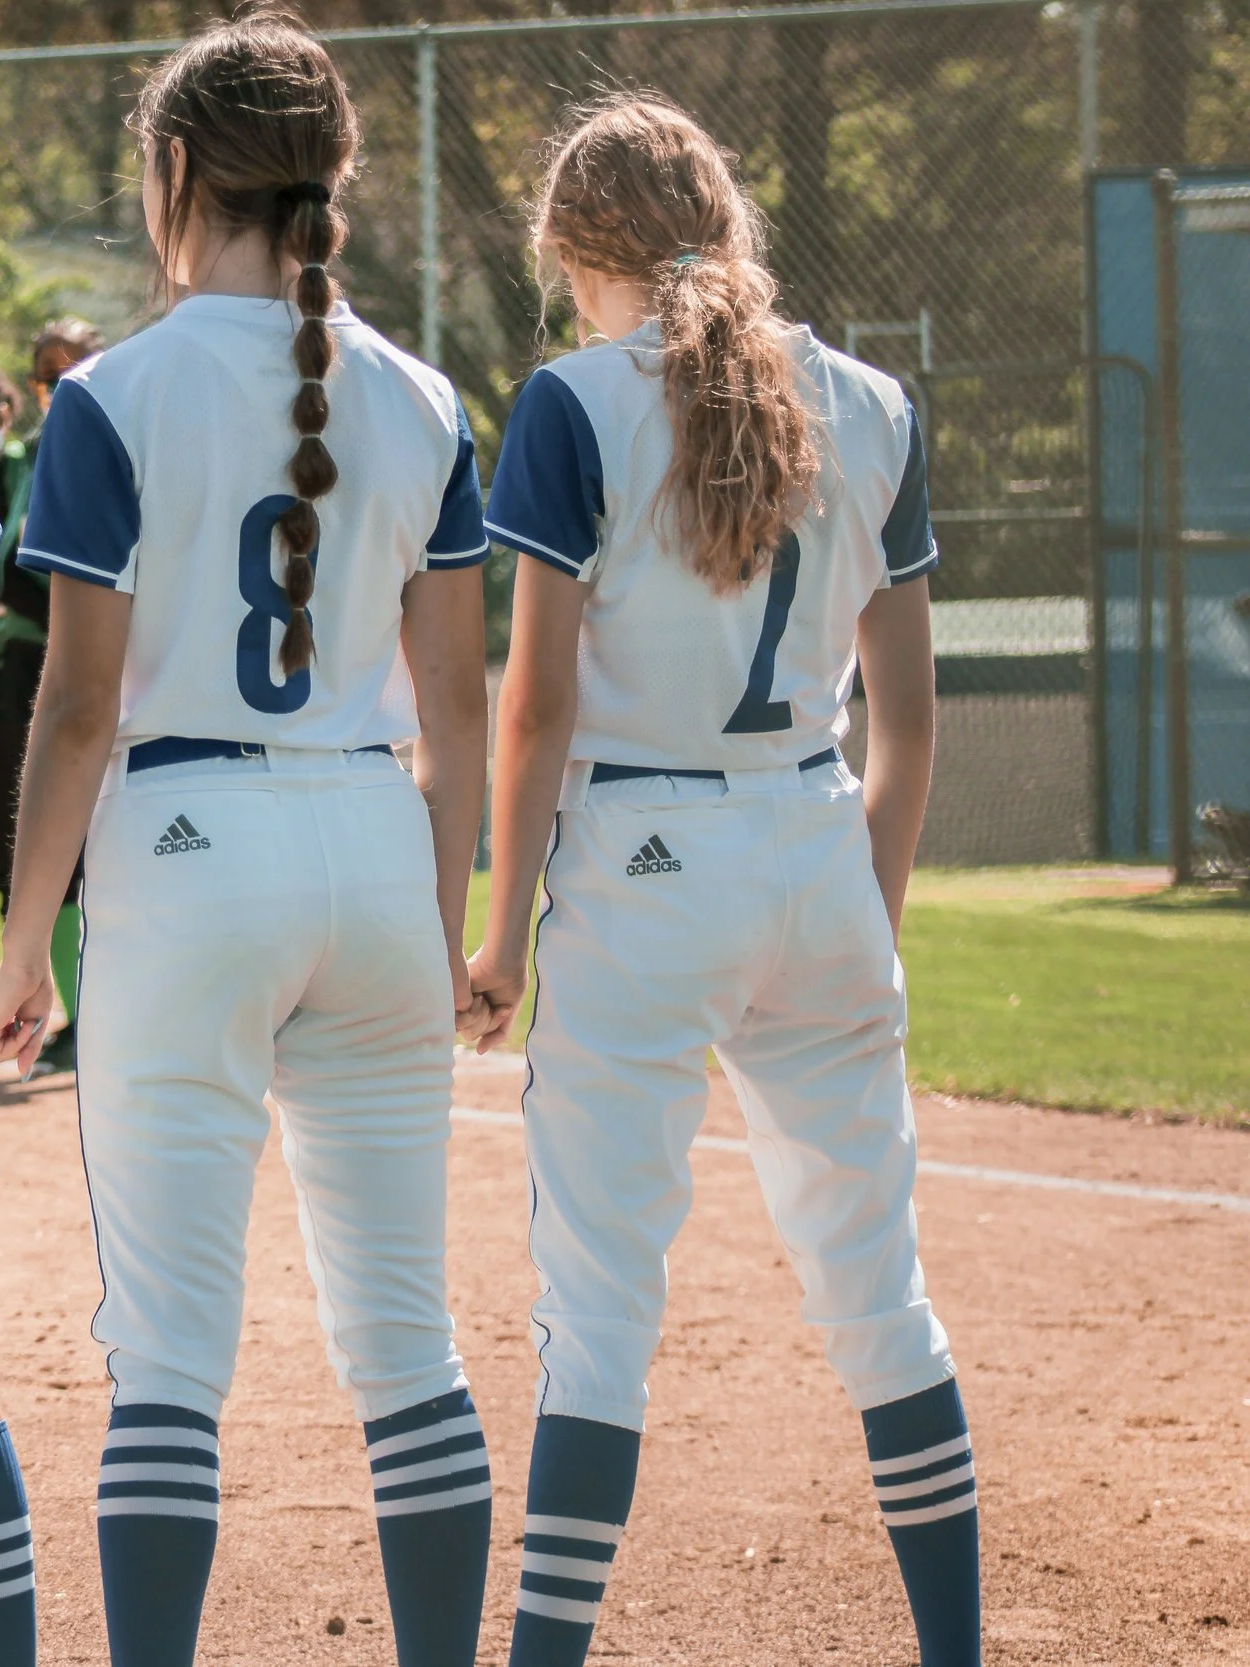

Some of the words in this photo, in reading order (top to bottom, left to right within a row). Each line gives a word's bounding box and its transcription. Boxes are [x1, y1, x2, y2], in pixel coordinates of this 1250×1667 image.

[236, 494, 321, 714] 8
[154, 837, 211, 856] adidas
[626, 859, 682, 876] adidas
